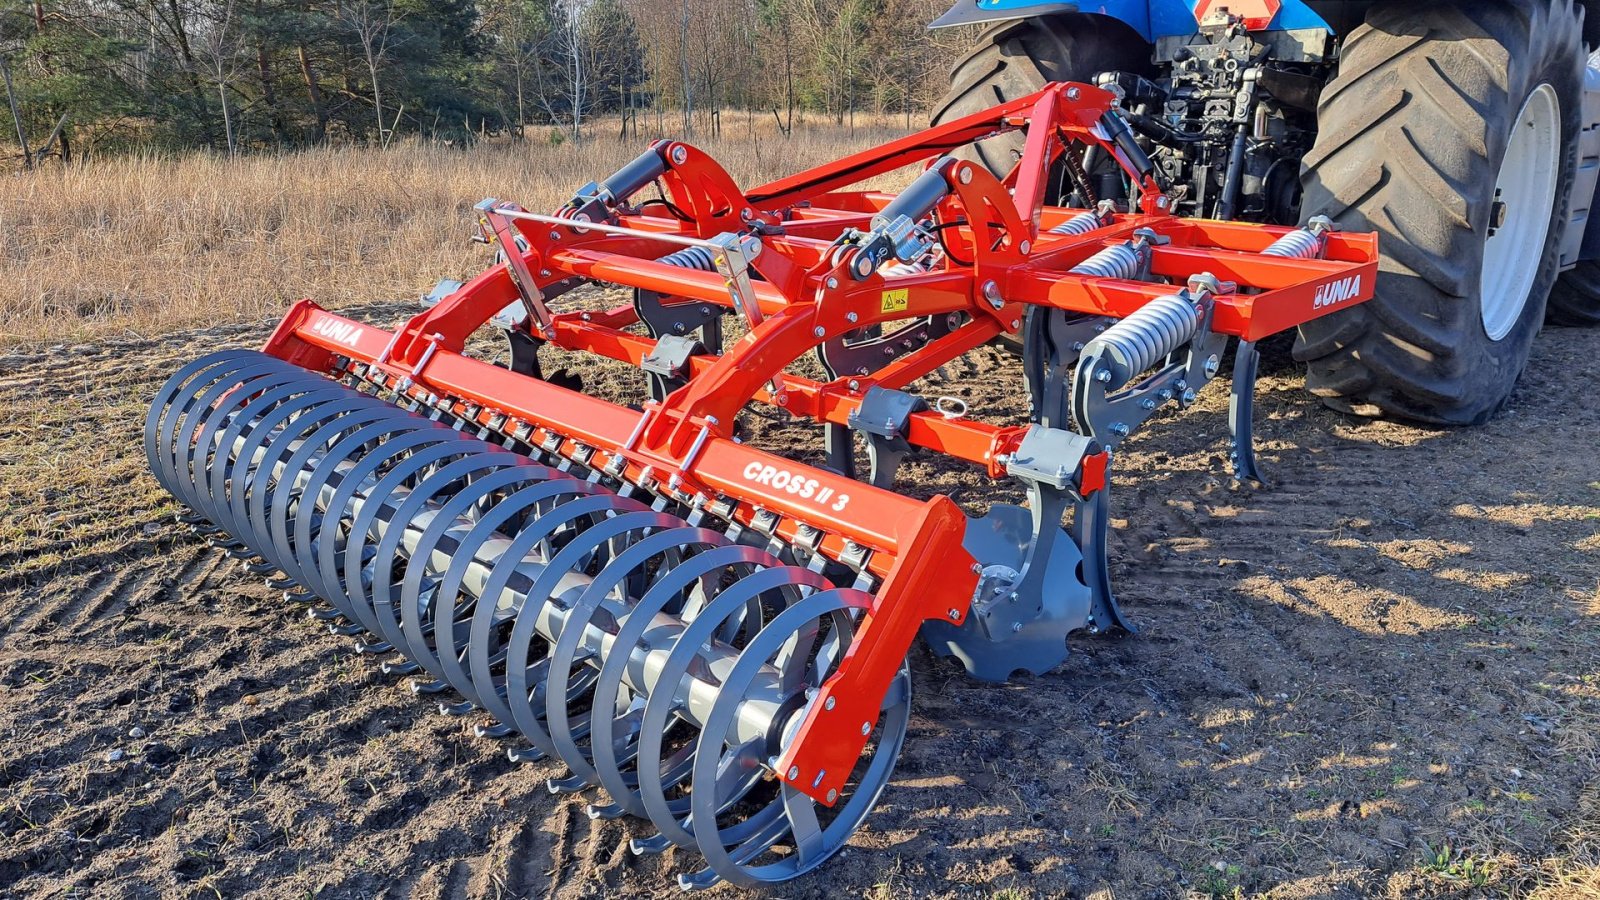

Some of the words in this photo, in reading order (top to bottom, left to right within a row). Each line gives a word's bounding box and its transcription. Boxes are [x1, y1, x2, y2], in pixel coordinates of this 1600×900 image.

[1323, 274, 1361, 306] UNIA
[319, 318, 364, 347] UNIA
[743, 461, 819, 498] CROSS
[814, 486, 835, 504] II
[831, 494, 850, 511] 3
